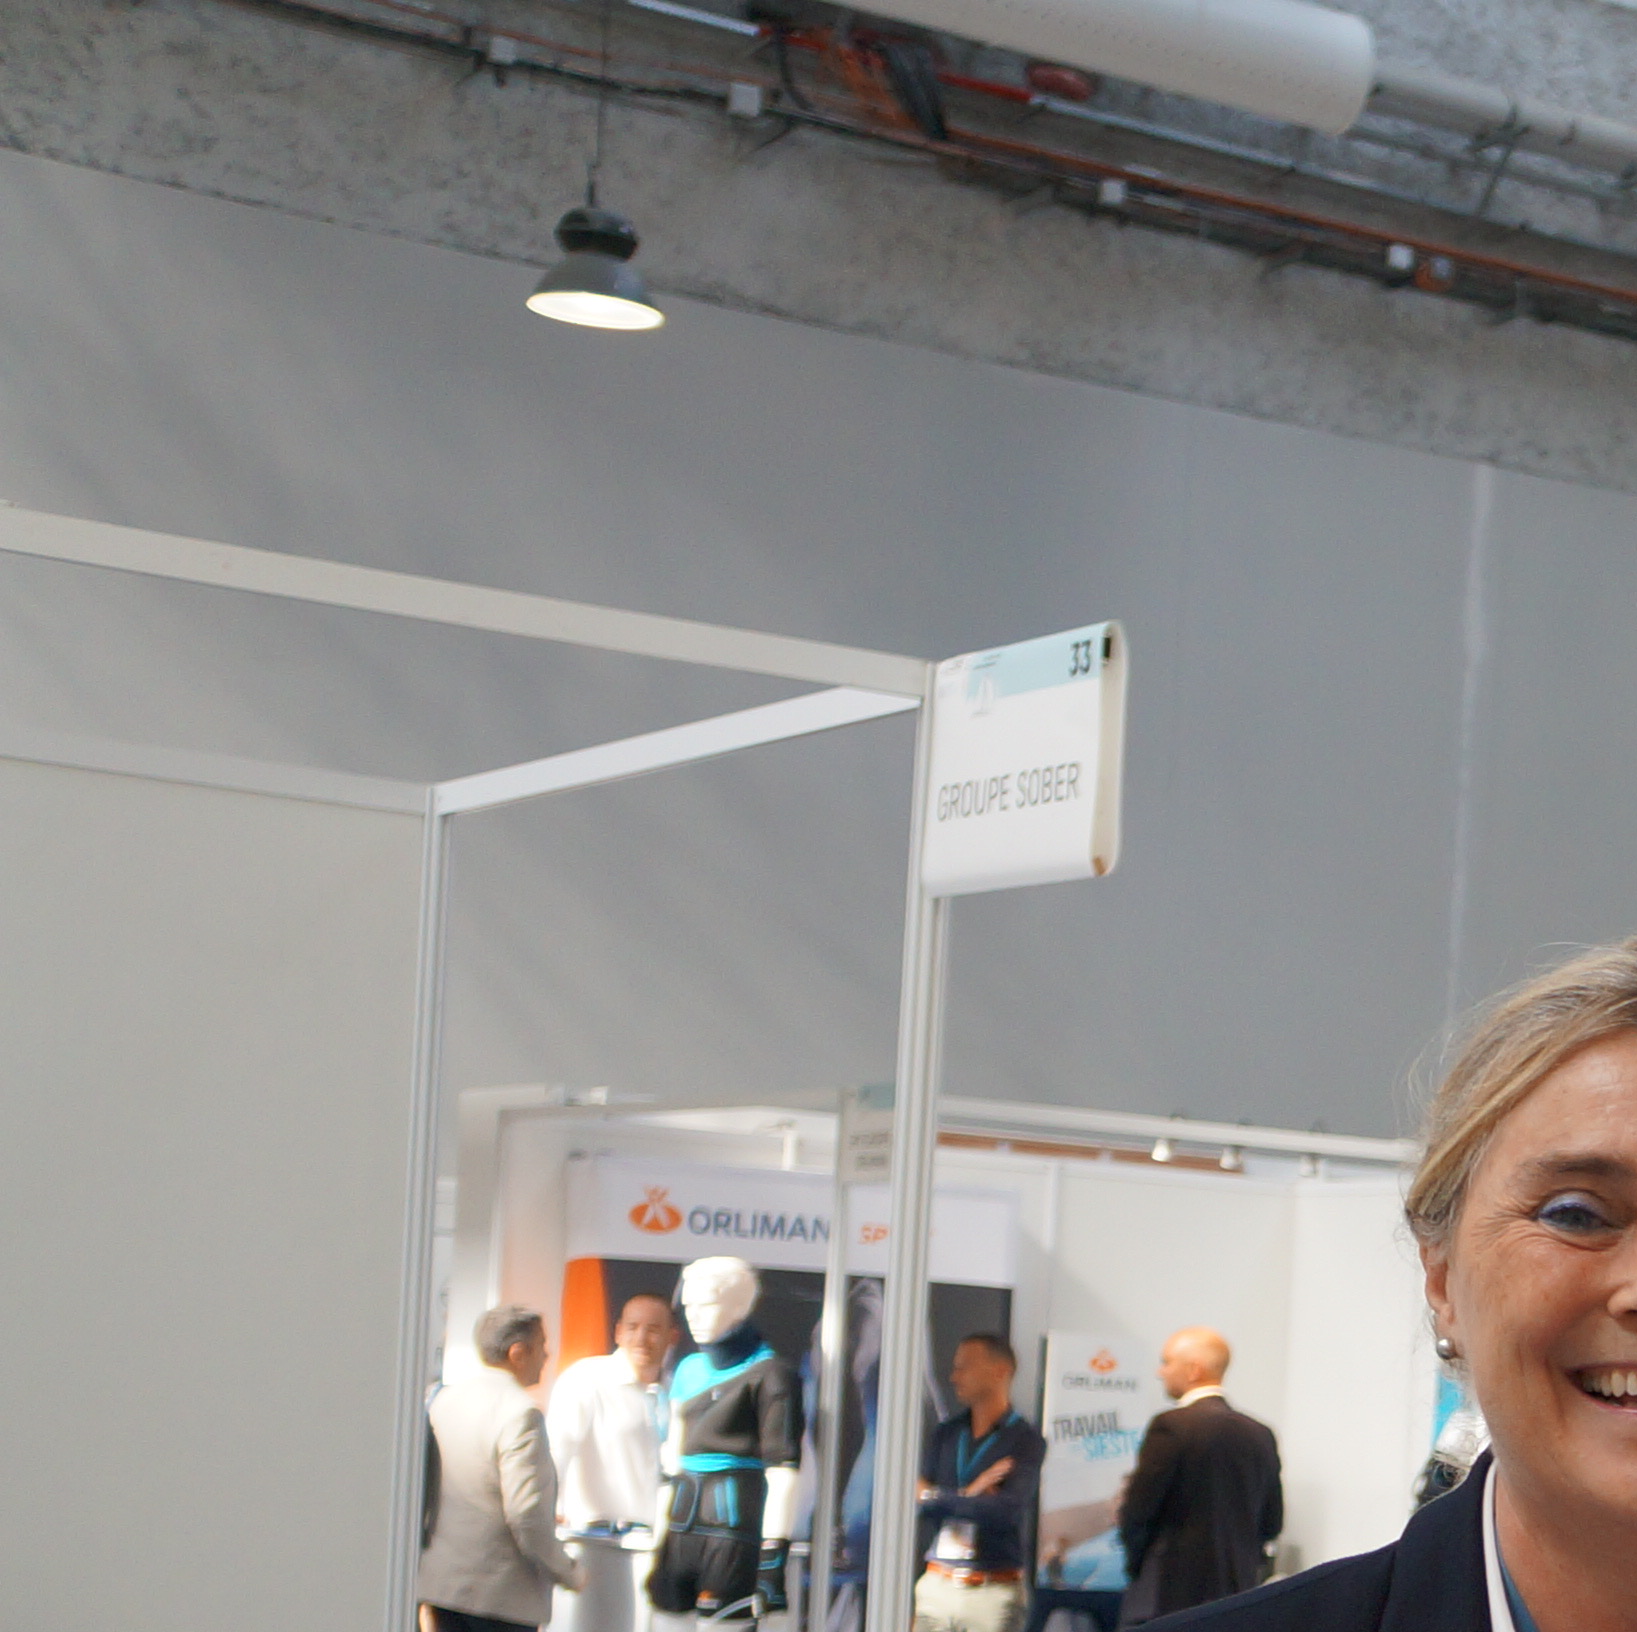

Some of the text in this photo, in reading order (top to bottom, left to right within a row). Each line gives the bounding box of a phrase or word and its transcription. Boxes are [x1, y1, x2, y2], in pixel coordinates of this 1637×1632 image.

[1068, 640, 1092, 676] 33
[937, 762, 1080, 821] GROUPE SOBER
